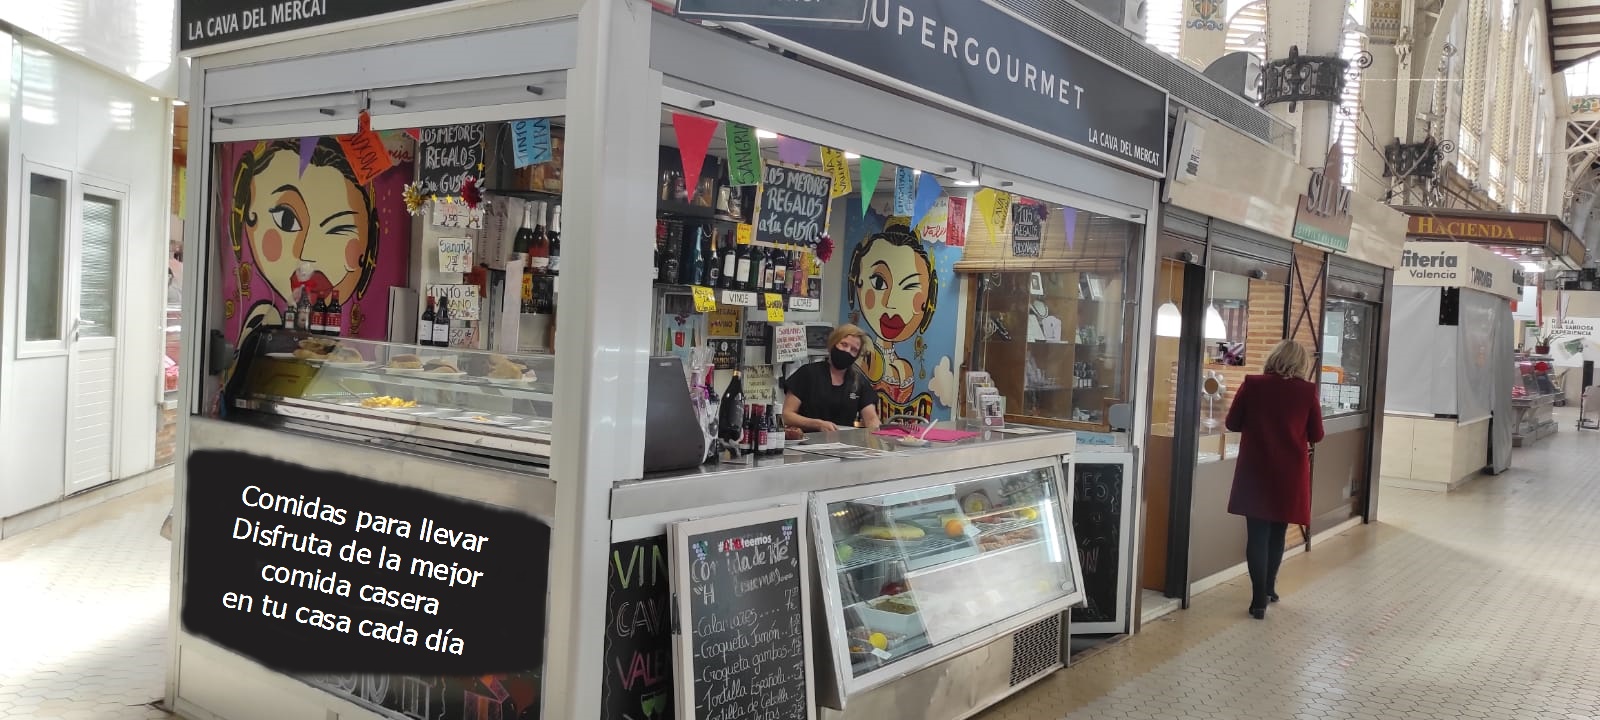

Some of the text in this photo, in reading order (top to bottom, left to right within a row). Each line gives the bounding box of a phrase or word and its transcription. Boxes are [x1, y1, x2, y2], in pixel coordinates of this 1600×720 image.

[188, 0, 327, 41] LA CAVA DEL MERCAT
[420, 123, 485, 149] LOS MEJORES
[1088, 127, 1160, 167] LA CAVA DEL MERCAT
[425, 146, 477, 170] REGALOS
[764, 166, 830, 198] LOS MEJORES
[767, 187, 824, 222] REGALOS
[783, 217, 819, 243] GUSTO
[1418, 216, 1515, 239] HACIENDA
[1410, 269, 1457, 279] Valencia
[700, 629, 750, 664] Croqueta
[702, 653, 751, 688] Croqueta
[702, 679, 748, 711] Tortilla
[750, 666, 787, 697] Española
